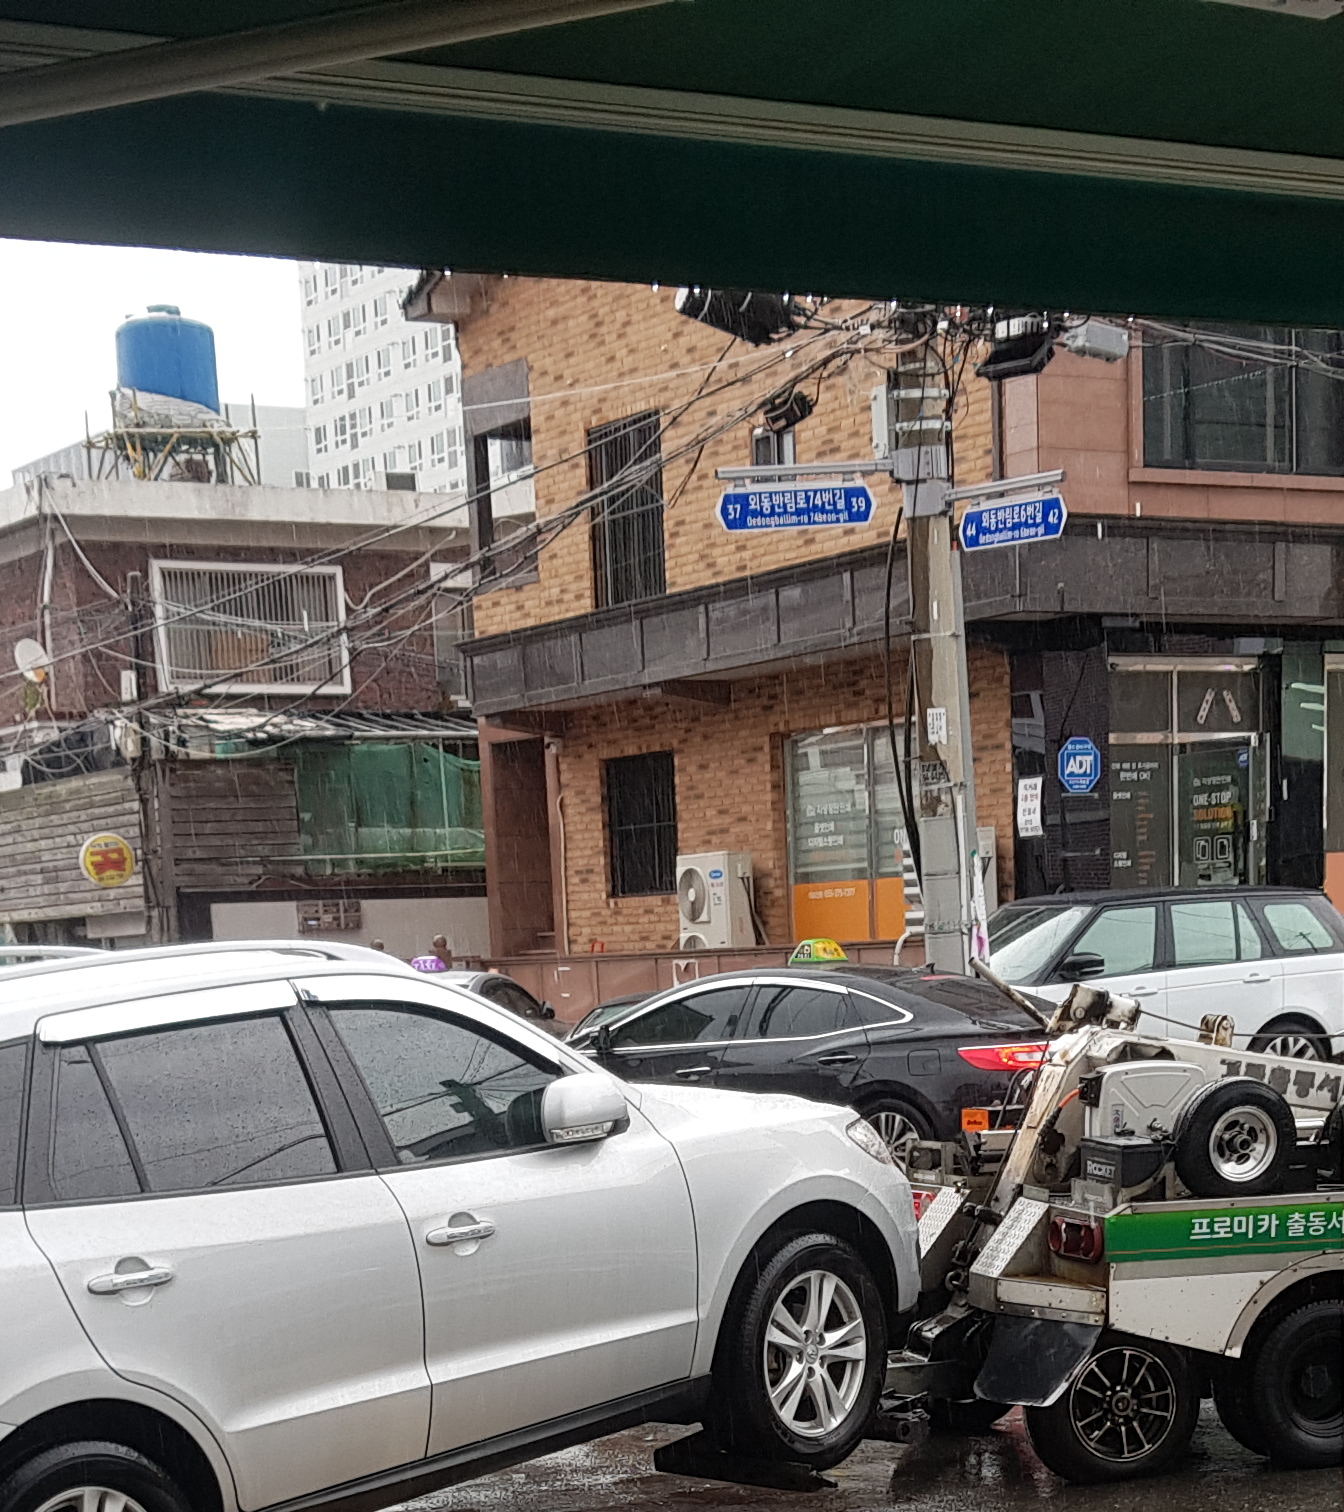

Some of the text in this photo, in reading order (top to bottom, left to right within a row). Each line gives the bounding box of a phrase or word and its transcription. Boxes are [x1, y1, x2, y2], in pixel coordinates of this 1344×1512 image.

[727, 488, 866, 519] 37 외동반림로74번길 39
[966, 501, 1059, 537] 44 외동반림로6번길 42
[1065, 754, 1094, 775] ADT
[1193, 791, 1232, 807] ONE-STOP
[1086, 1159, 1116, 1178] ROCKET
[1189, 1213, 1280, 1240] 프로미카
